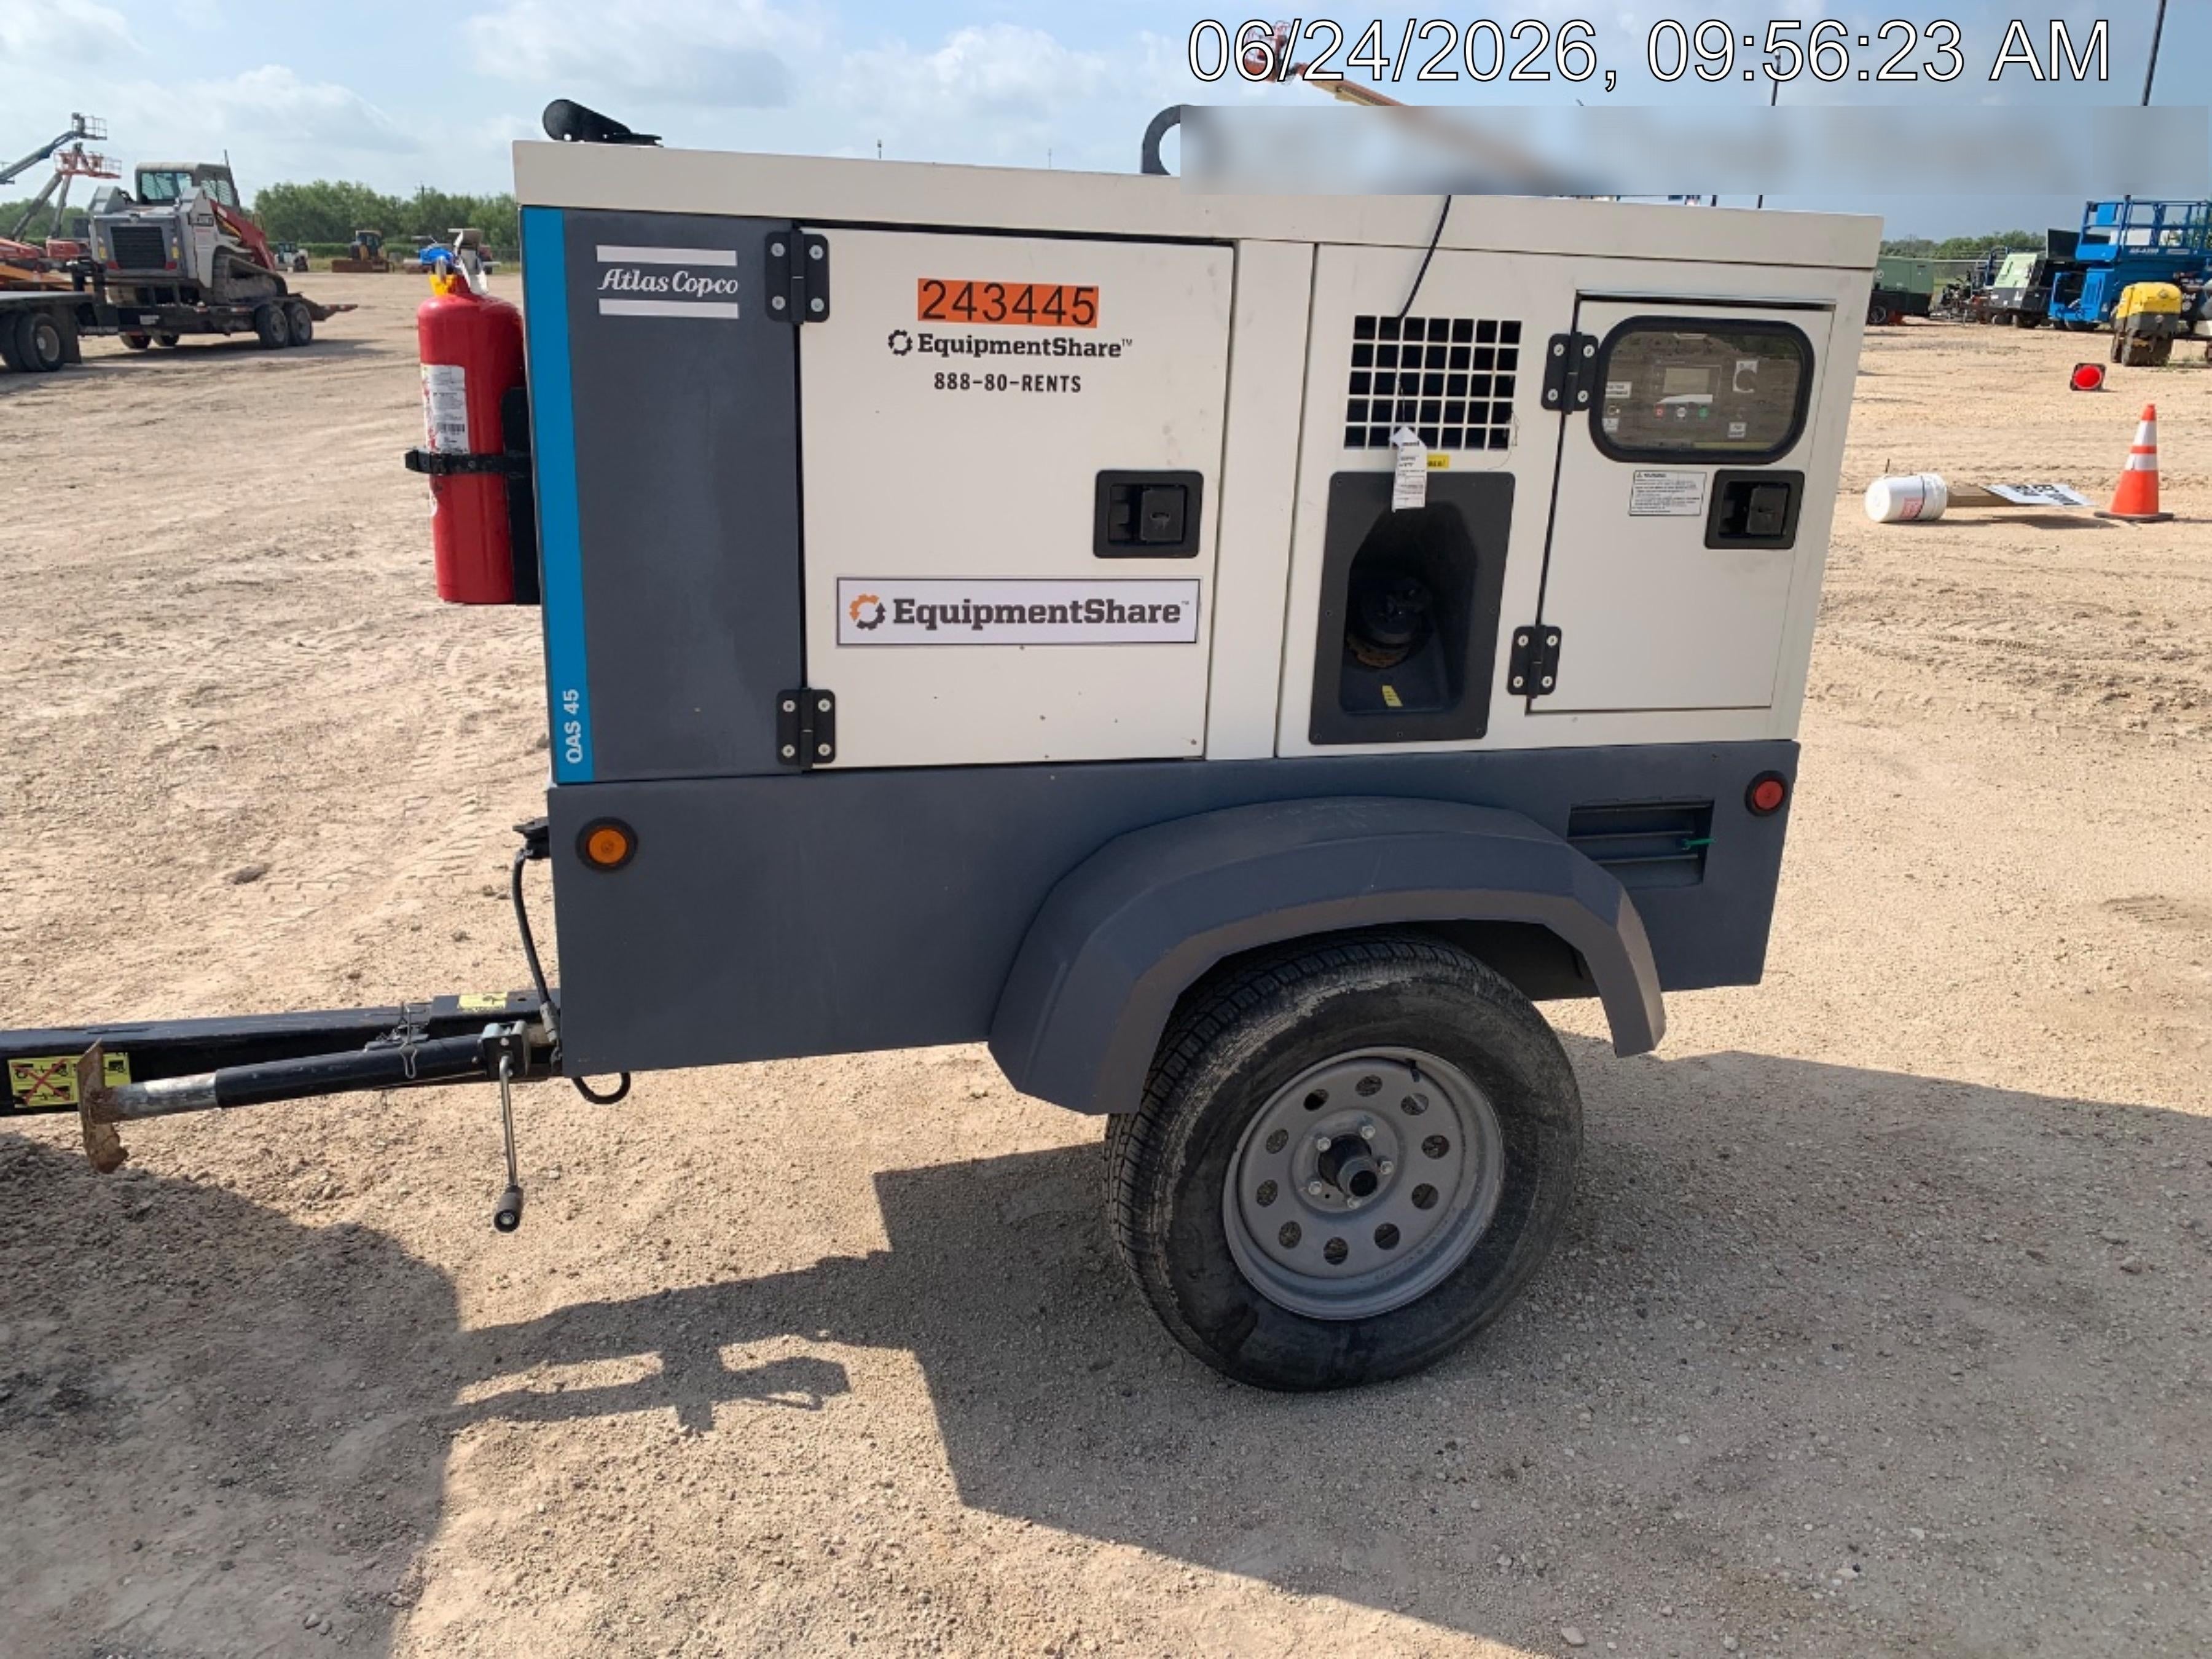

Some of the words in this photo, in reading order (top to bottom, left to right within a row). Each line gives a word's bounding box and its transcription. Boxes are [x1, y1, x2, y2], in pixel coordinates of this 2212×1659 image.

[597, 268, 669, 293] Atlas
[672, 269, 739, 297] Copco
[922, 280, 1096, 326] 243445
[934, 372, 1081, 393] 888-80-RENTS
[563, 688, 579, 715] 45
